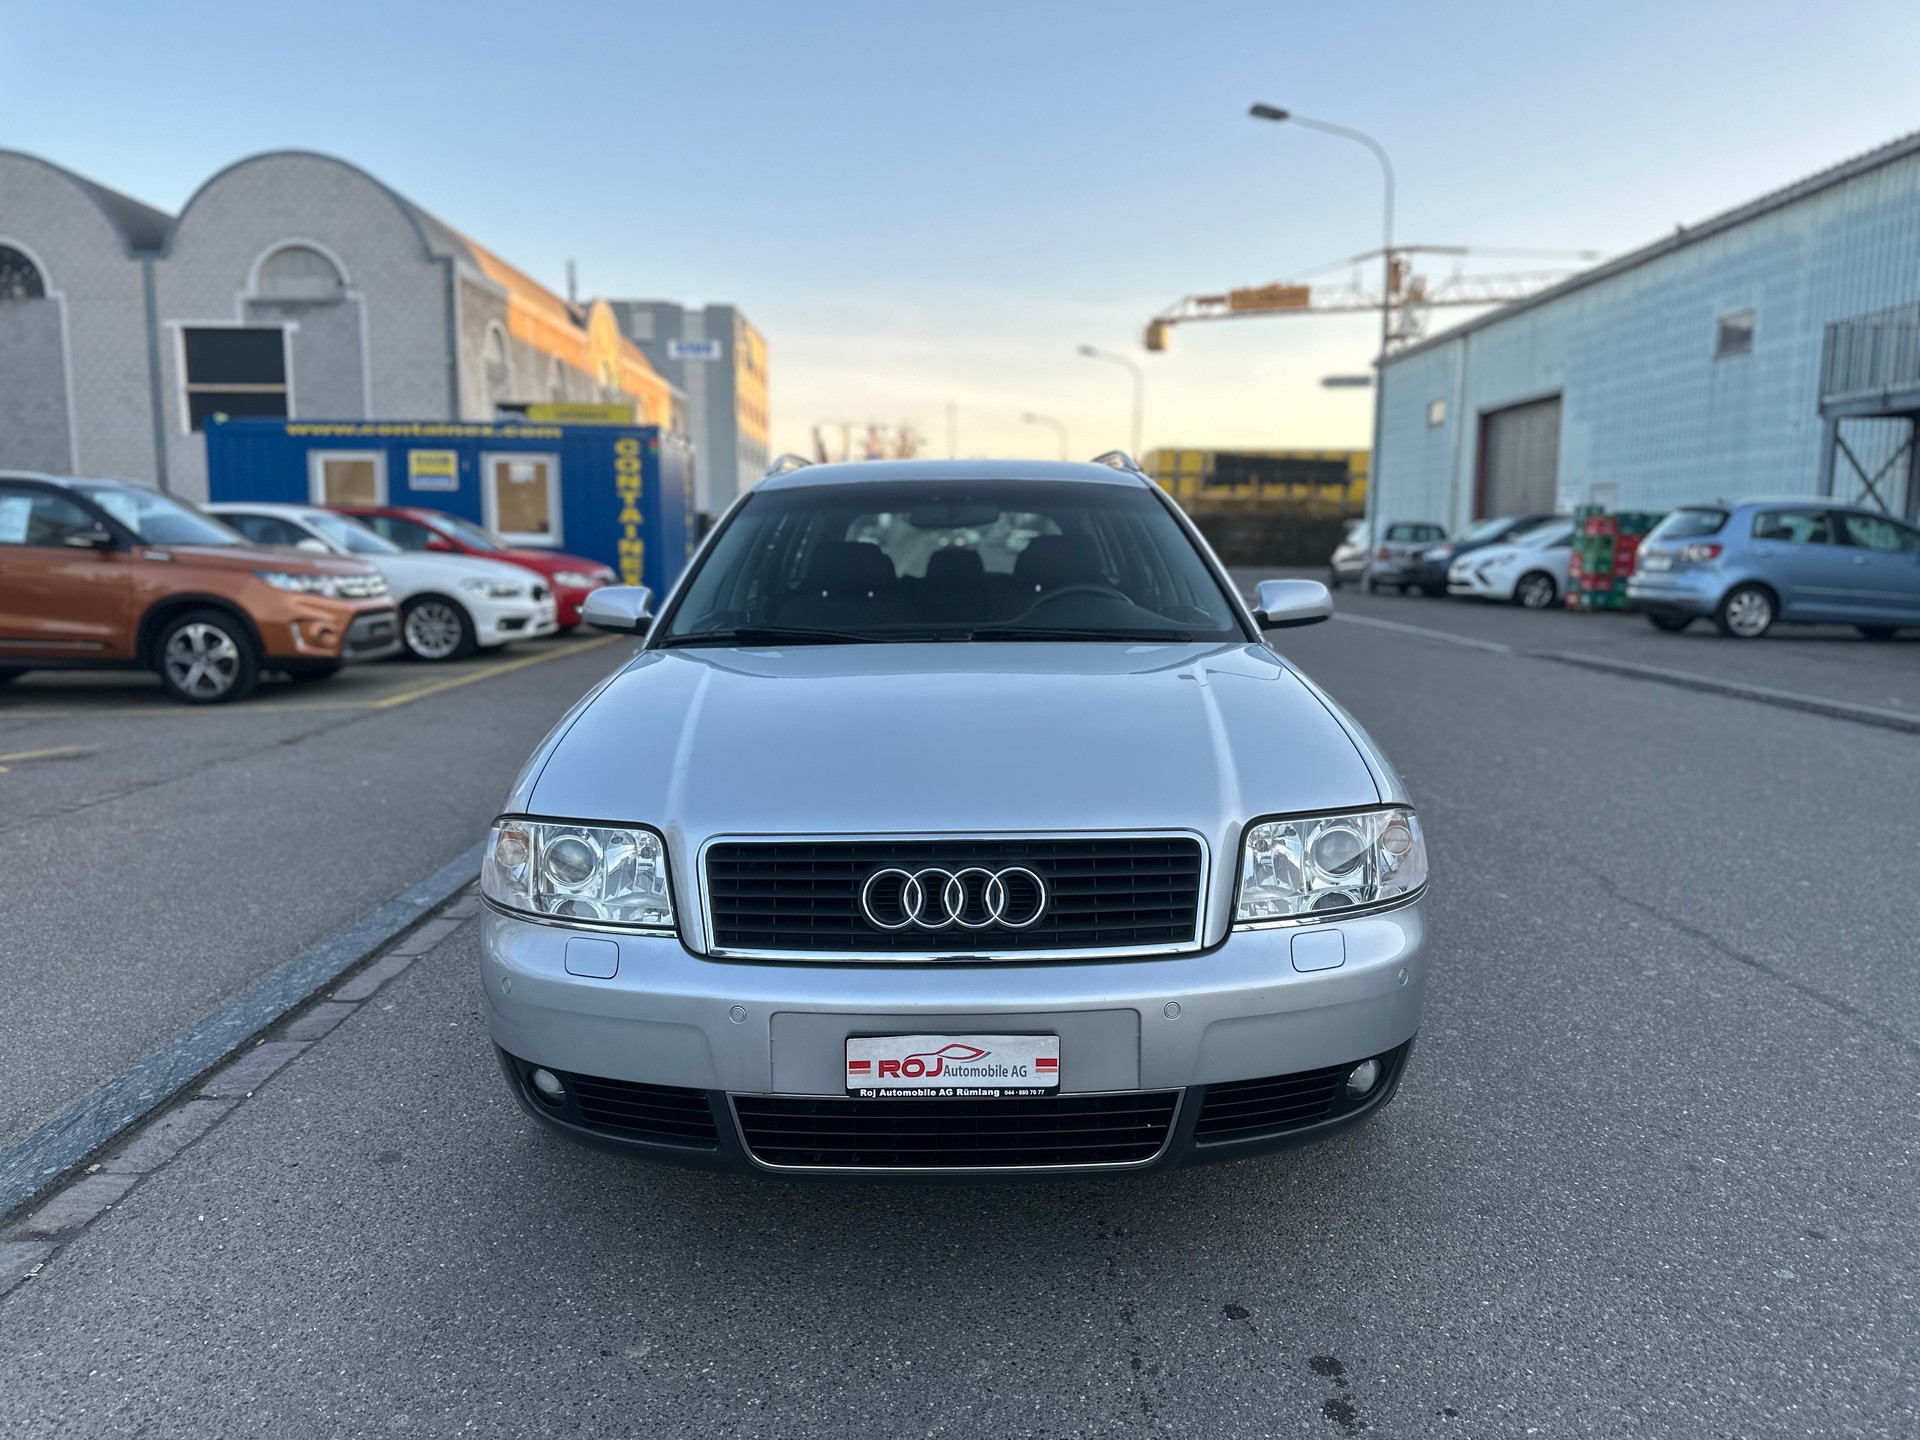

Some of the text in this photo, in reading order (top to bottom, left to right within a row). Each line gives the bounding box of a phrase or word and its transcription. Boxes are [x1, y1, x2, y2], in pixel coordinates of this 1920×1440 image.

[878, 1058, 1027, 1078] ROJ Automobile AG
[860, 1089, 876, 1098] Roj
[879, 1088, 936, 1096] Automobile
[939, 1088, 953, 1096] AG
[957, 1088, 1000, 1097] Rümlang
